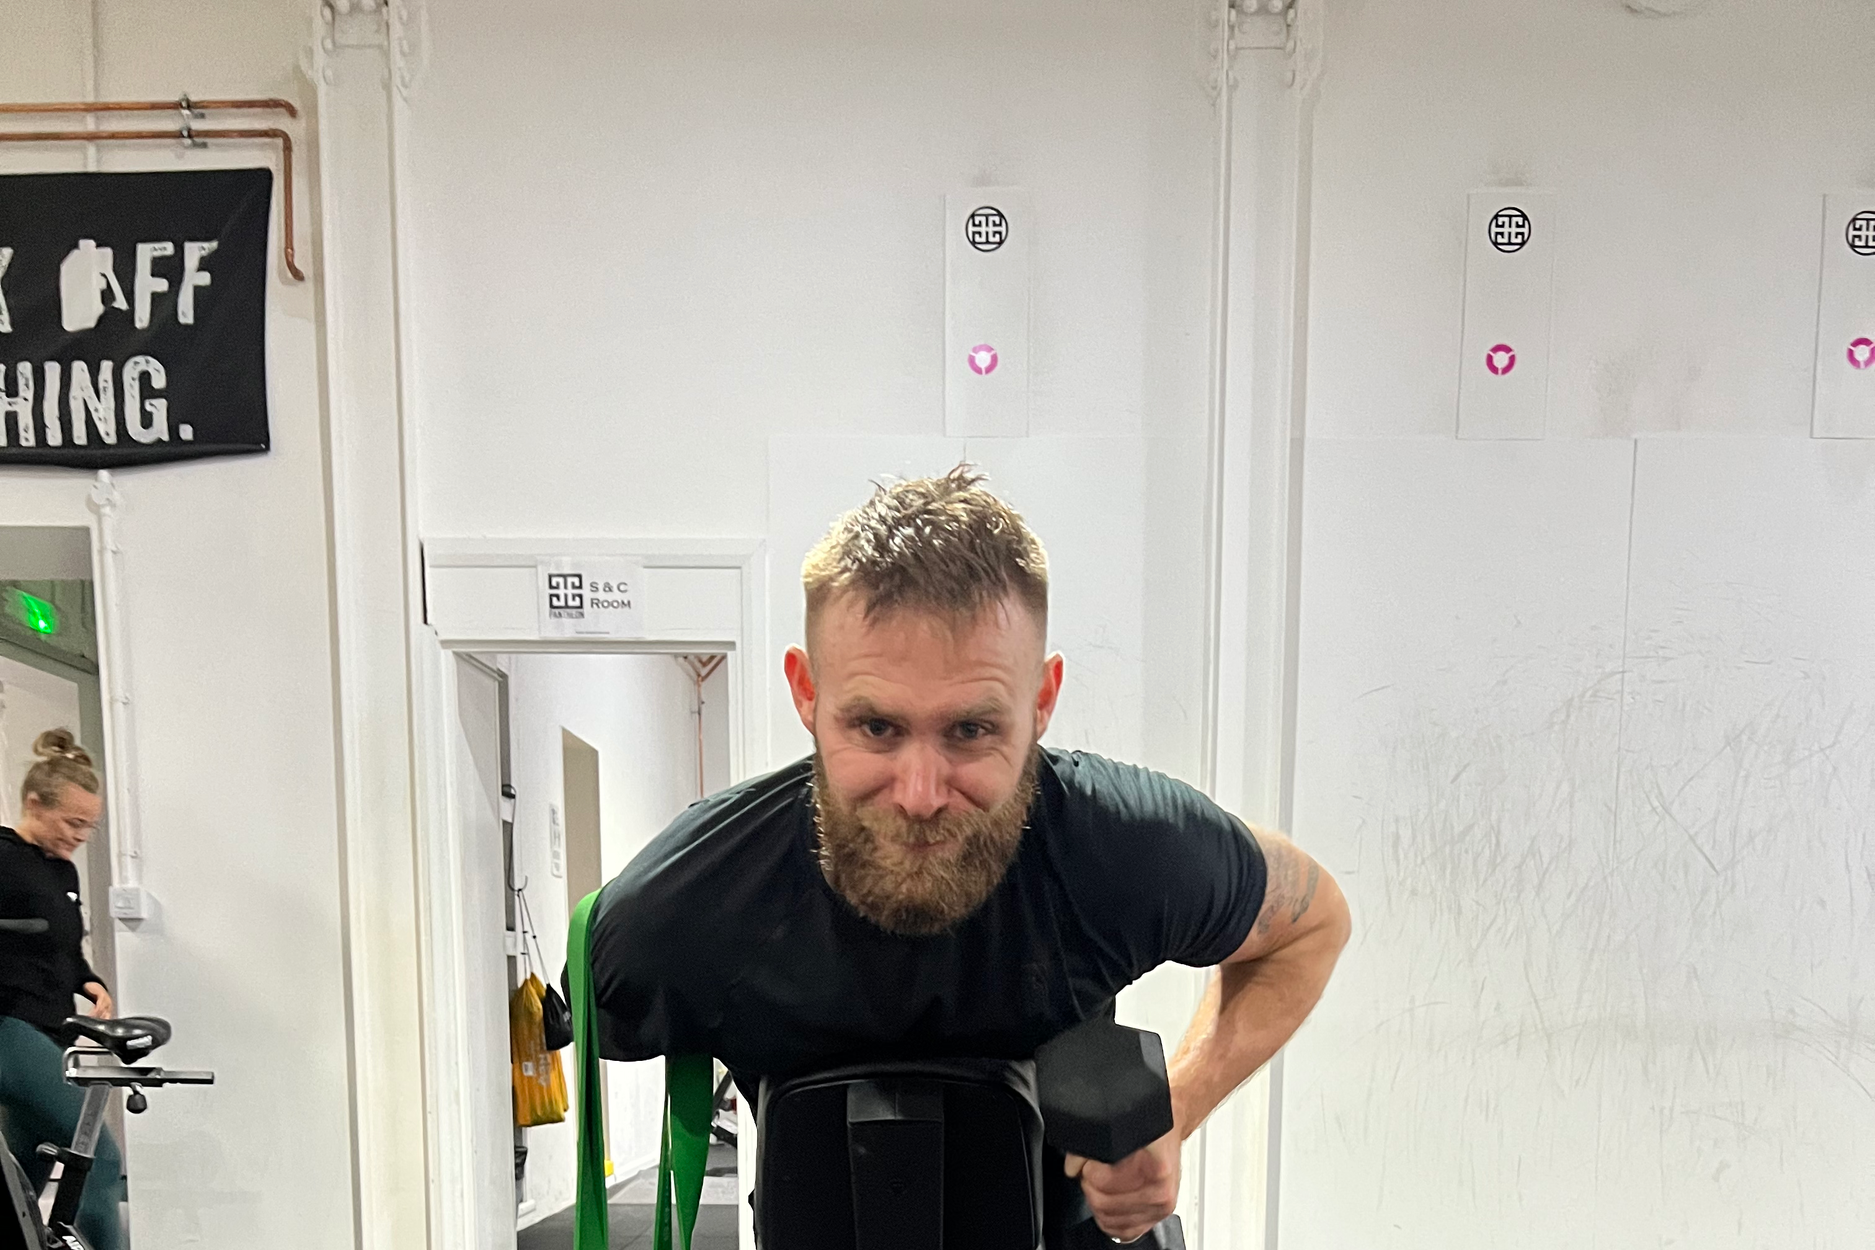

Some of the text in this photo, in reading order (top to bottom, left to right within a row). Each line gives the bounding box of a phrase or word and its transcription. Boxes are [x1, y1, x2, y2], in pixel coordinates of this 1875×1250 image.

[589, 581, 628, 594] S & C
